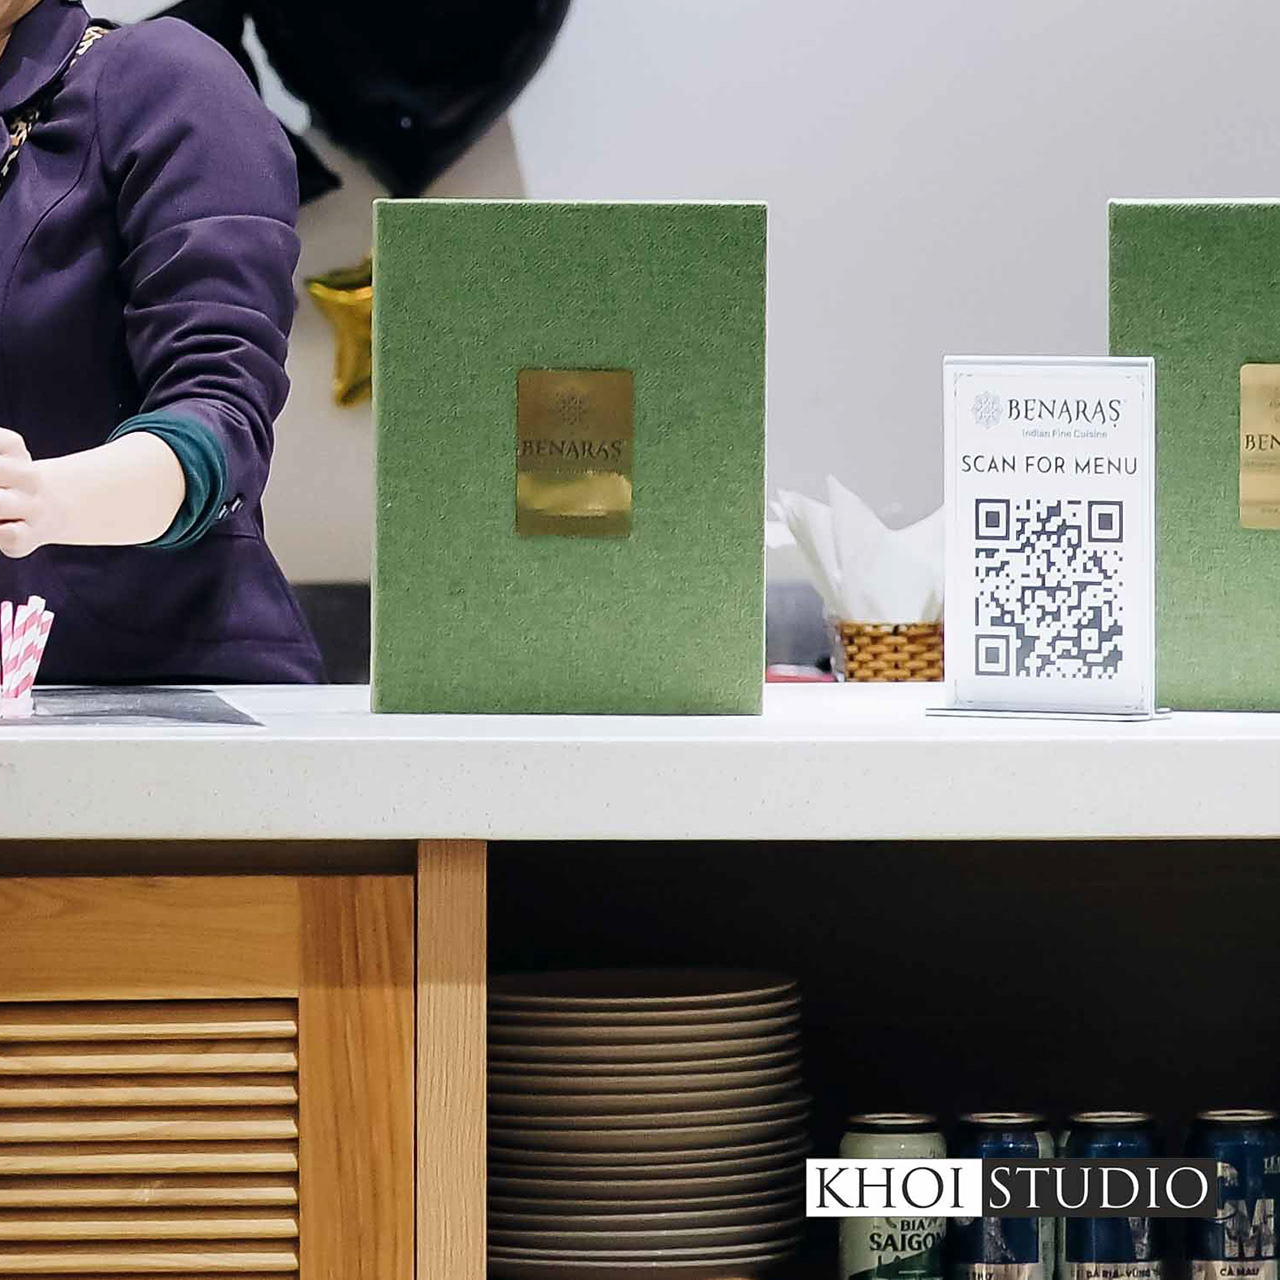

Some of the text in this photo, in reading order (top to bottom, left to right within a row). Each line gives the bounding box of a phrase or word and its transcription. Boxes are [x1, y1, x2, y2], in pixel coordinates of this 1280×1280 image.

[1022, 429, 1108, 439] Indian Fine Cuisine
[962, 455, 1138, 475] SCAN FOR MENU
[900, 1219, 926, 1232] BIA
